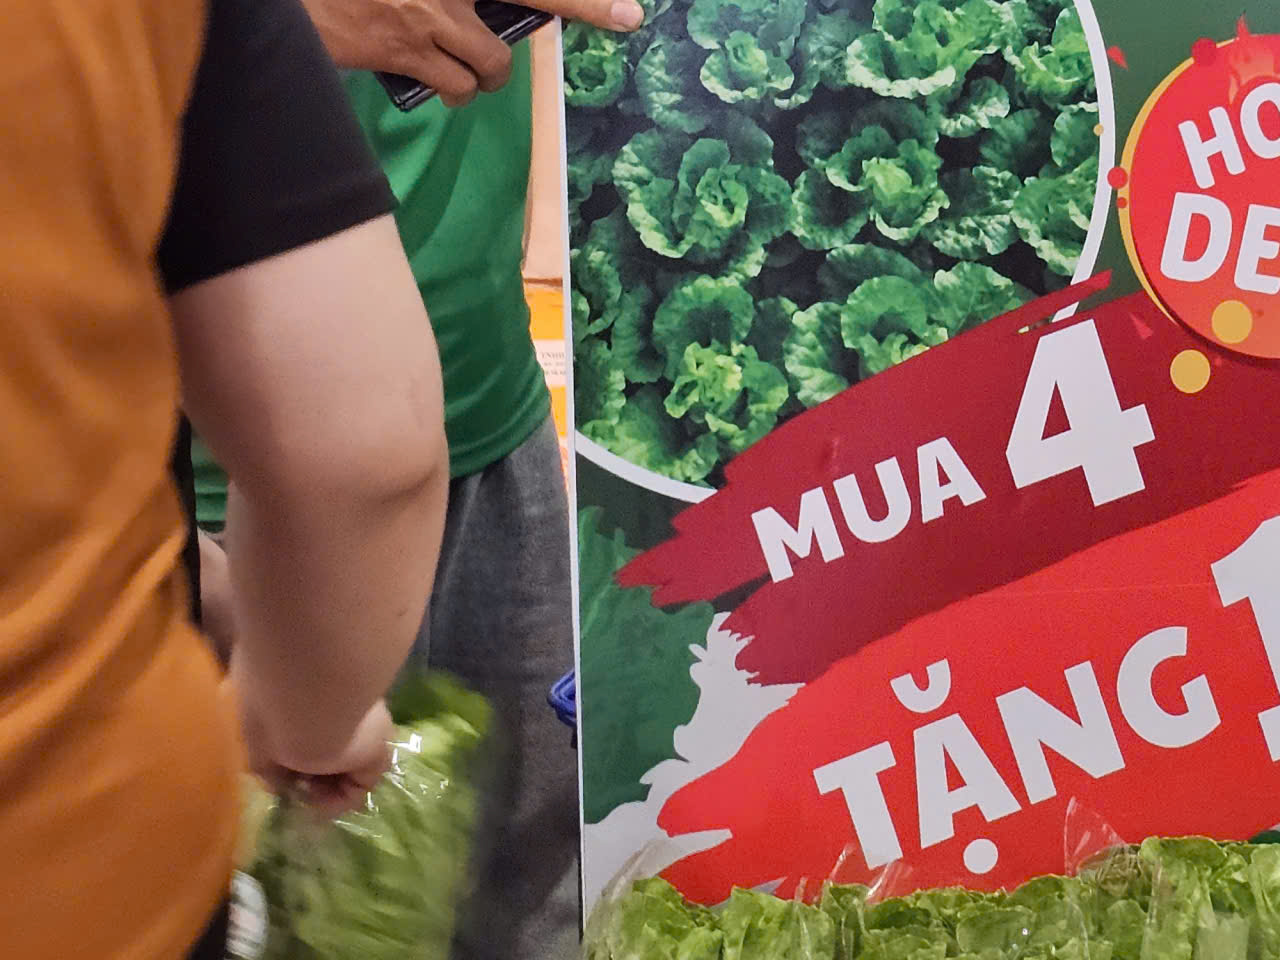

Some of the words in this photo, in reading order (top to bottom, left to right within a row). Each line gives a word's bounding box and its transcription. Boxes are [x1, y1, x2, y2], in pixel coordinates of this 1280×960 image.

[749, 436, 989, 584] MUA
[1005, 318, 1156, 508] 4
[813, 624, 1222, 876] TẶNG
